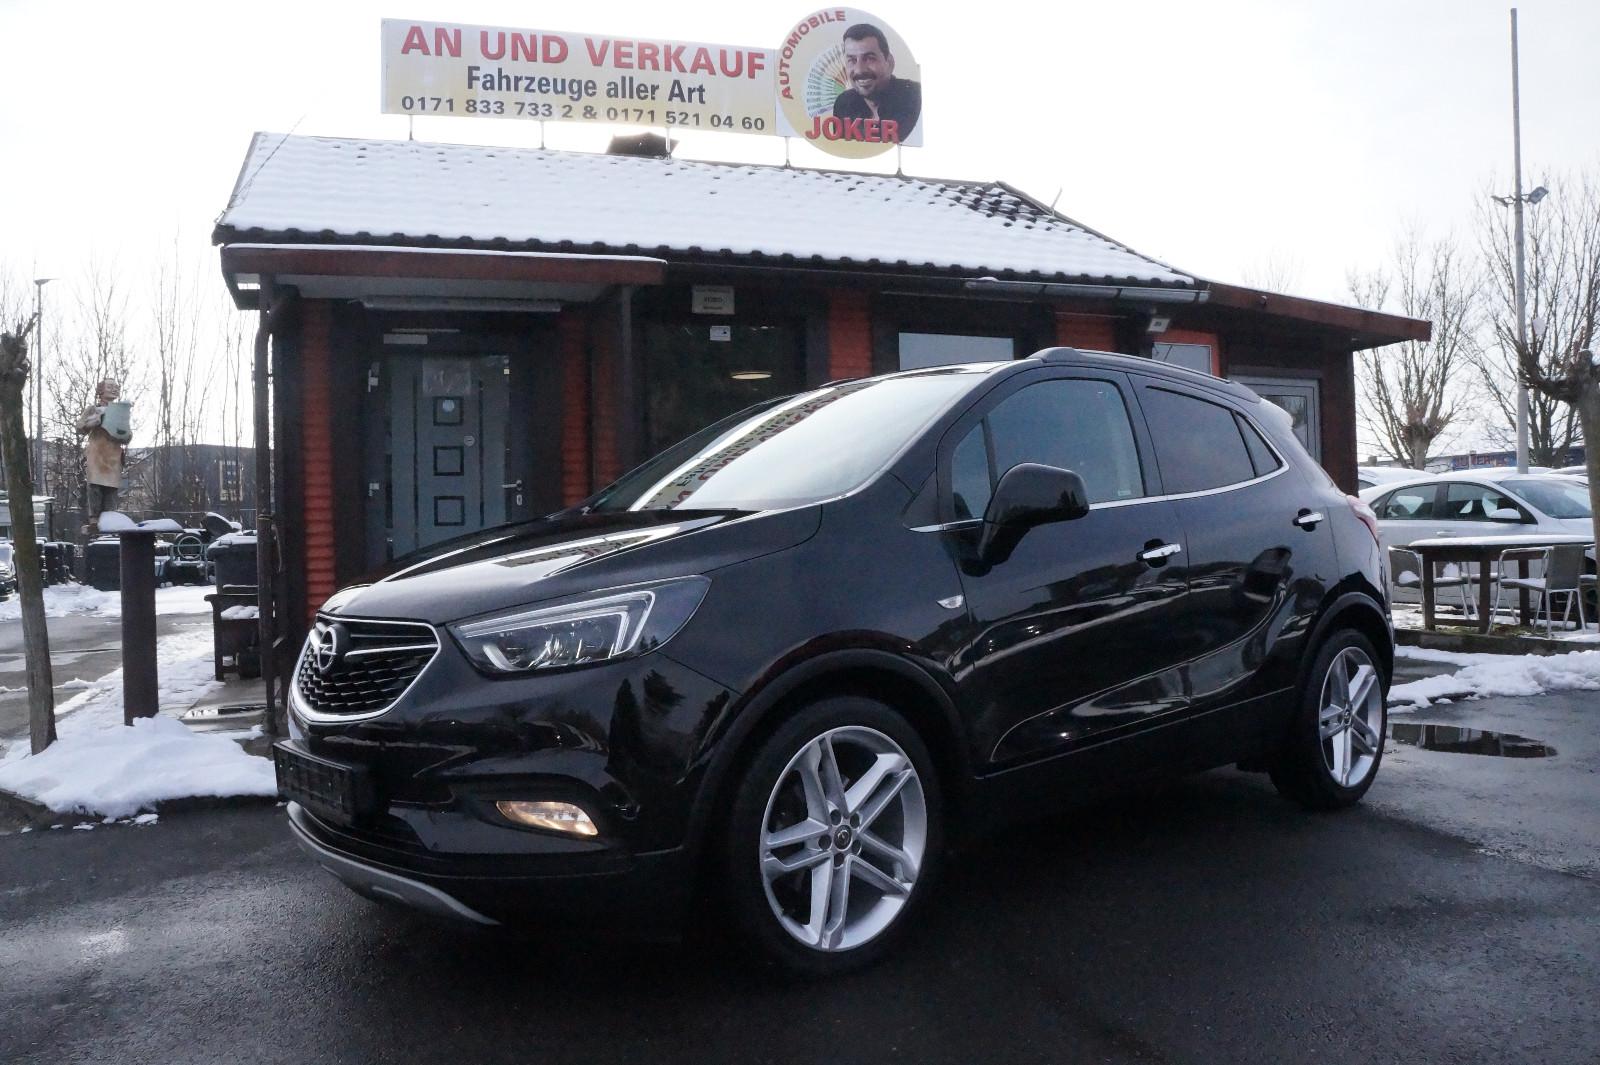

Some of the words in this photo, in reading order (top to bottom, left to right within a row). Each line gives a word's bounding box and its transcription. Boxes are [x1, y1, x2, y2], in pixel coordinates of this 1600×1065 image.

[401, 26, 462, 57] AN
[480, 30, 569, 64] UND
[584, 38, 765, 80] VERKAUF
[778, 10, 846, 100] AUTOMOBILE
[467, 66, 598, 102] Fahrzeuge
[606, 75, 659, 101] aller
[668, 79, 706, 104] Art
[401, 95, 455, 113] 0171
[465, 99, 505, 115] 833
[514, 101, 553, 117] 733
[561, 104, 574, 119] 2
[583, 105, 598, 120] &
[606, 107, 656, 124] 0171
[666, 111, 701, 126] 521
[710, 114, 735, 129] 04
[741, 116, 766, 131] 60
[805, 115, 901, 145] JOKER
